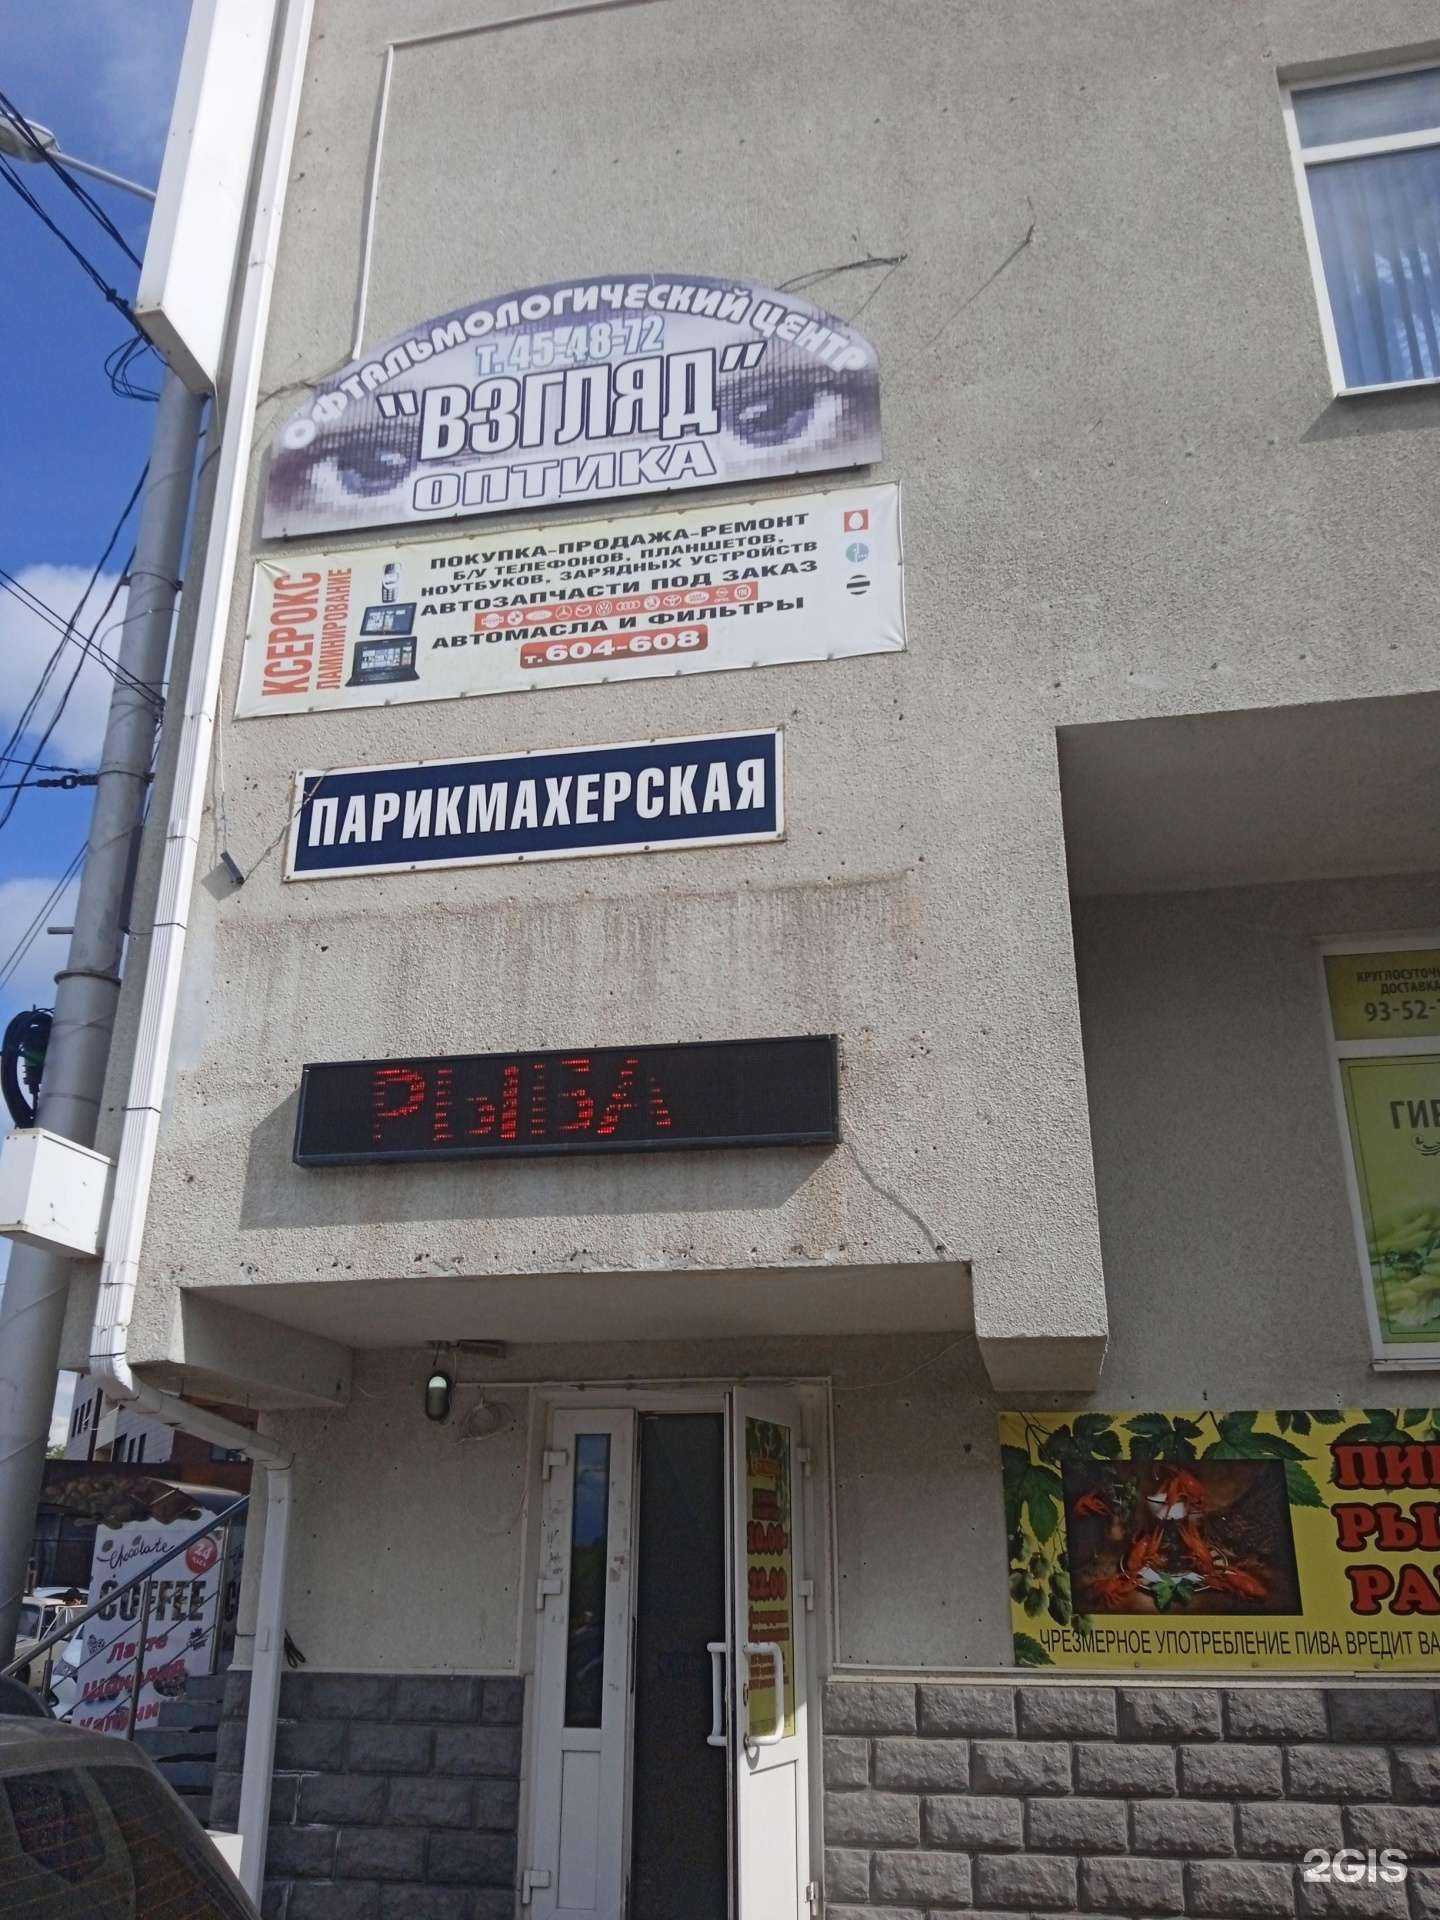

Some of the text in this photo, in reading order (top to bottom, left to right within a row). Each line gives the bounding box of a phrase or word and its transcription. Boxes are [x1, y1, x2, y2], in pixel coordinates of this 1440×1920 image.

[281, 281, 869, 450] ОФТАЛЬМОЛОГИЧЕСКИЙ ЦЕНТР
[412, 440, 716, 512] ОПТИКА
[420, 560, 819, 617] АВТОЗАПЧАСТИ ПОД ЗАКАЗ
[453, 567, 488, 581] Б/У
[559, 558, 682, 582] ЗАРЯДНЫХ
[690, 541, 818, 567] УСТРОЙСТВ
[261, 571, 322, 697] КСЕРОКС
[316, 567, 352, 691] ЛАМИНИРОВАНИЕ
[431, 597, 805, 650] АВТОМАСЛА И ФИЛЬТРЫ
[307, 757, 766, 848] ПАРИКМАХЕРСКАЯ
[1364, 999, 1440, 1022] 93-52-
[1345, 1563, 1440, 1616] РА
[1039, 1629, 1153, 1655] ЧРЕЗМЕРНОЕ
[1156, 1630, 1292, 1656] УПОТРЕБЛЕНИЕ
[1295, 1631, 1343, 1656] ПИВА
[1345, 1631, 1414, 1660] ВРЕДИТ
